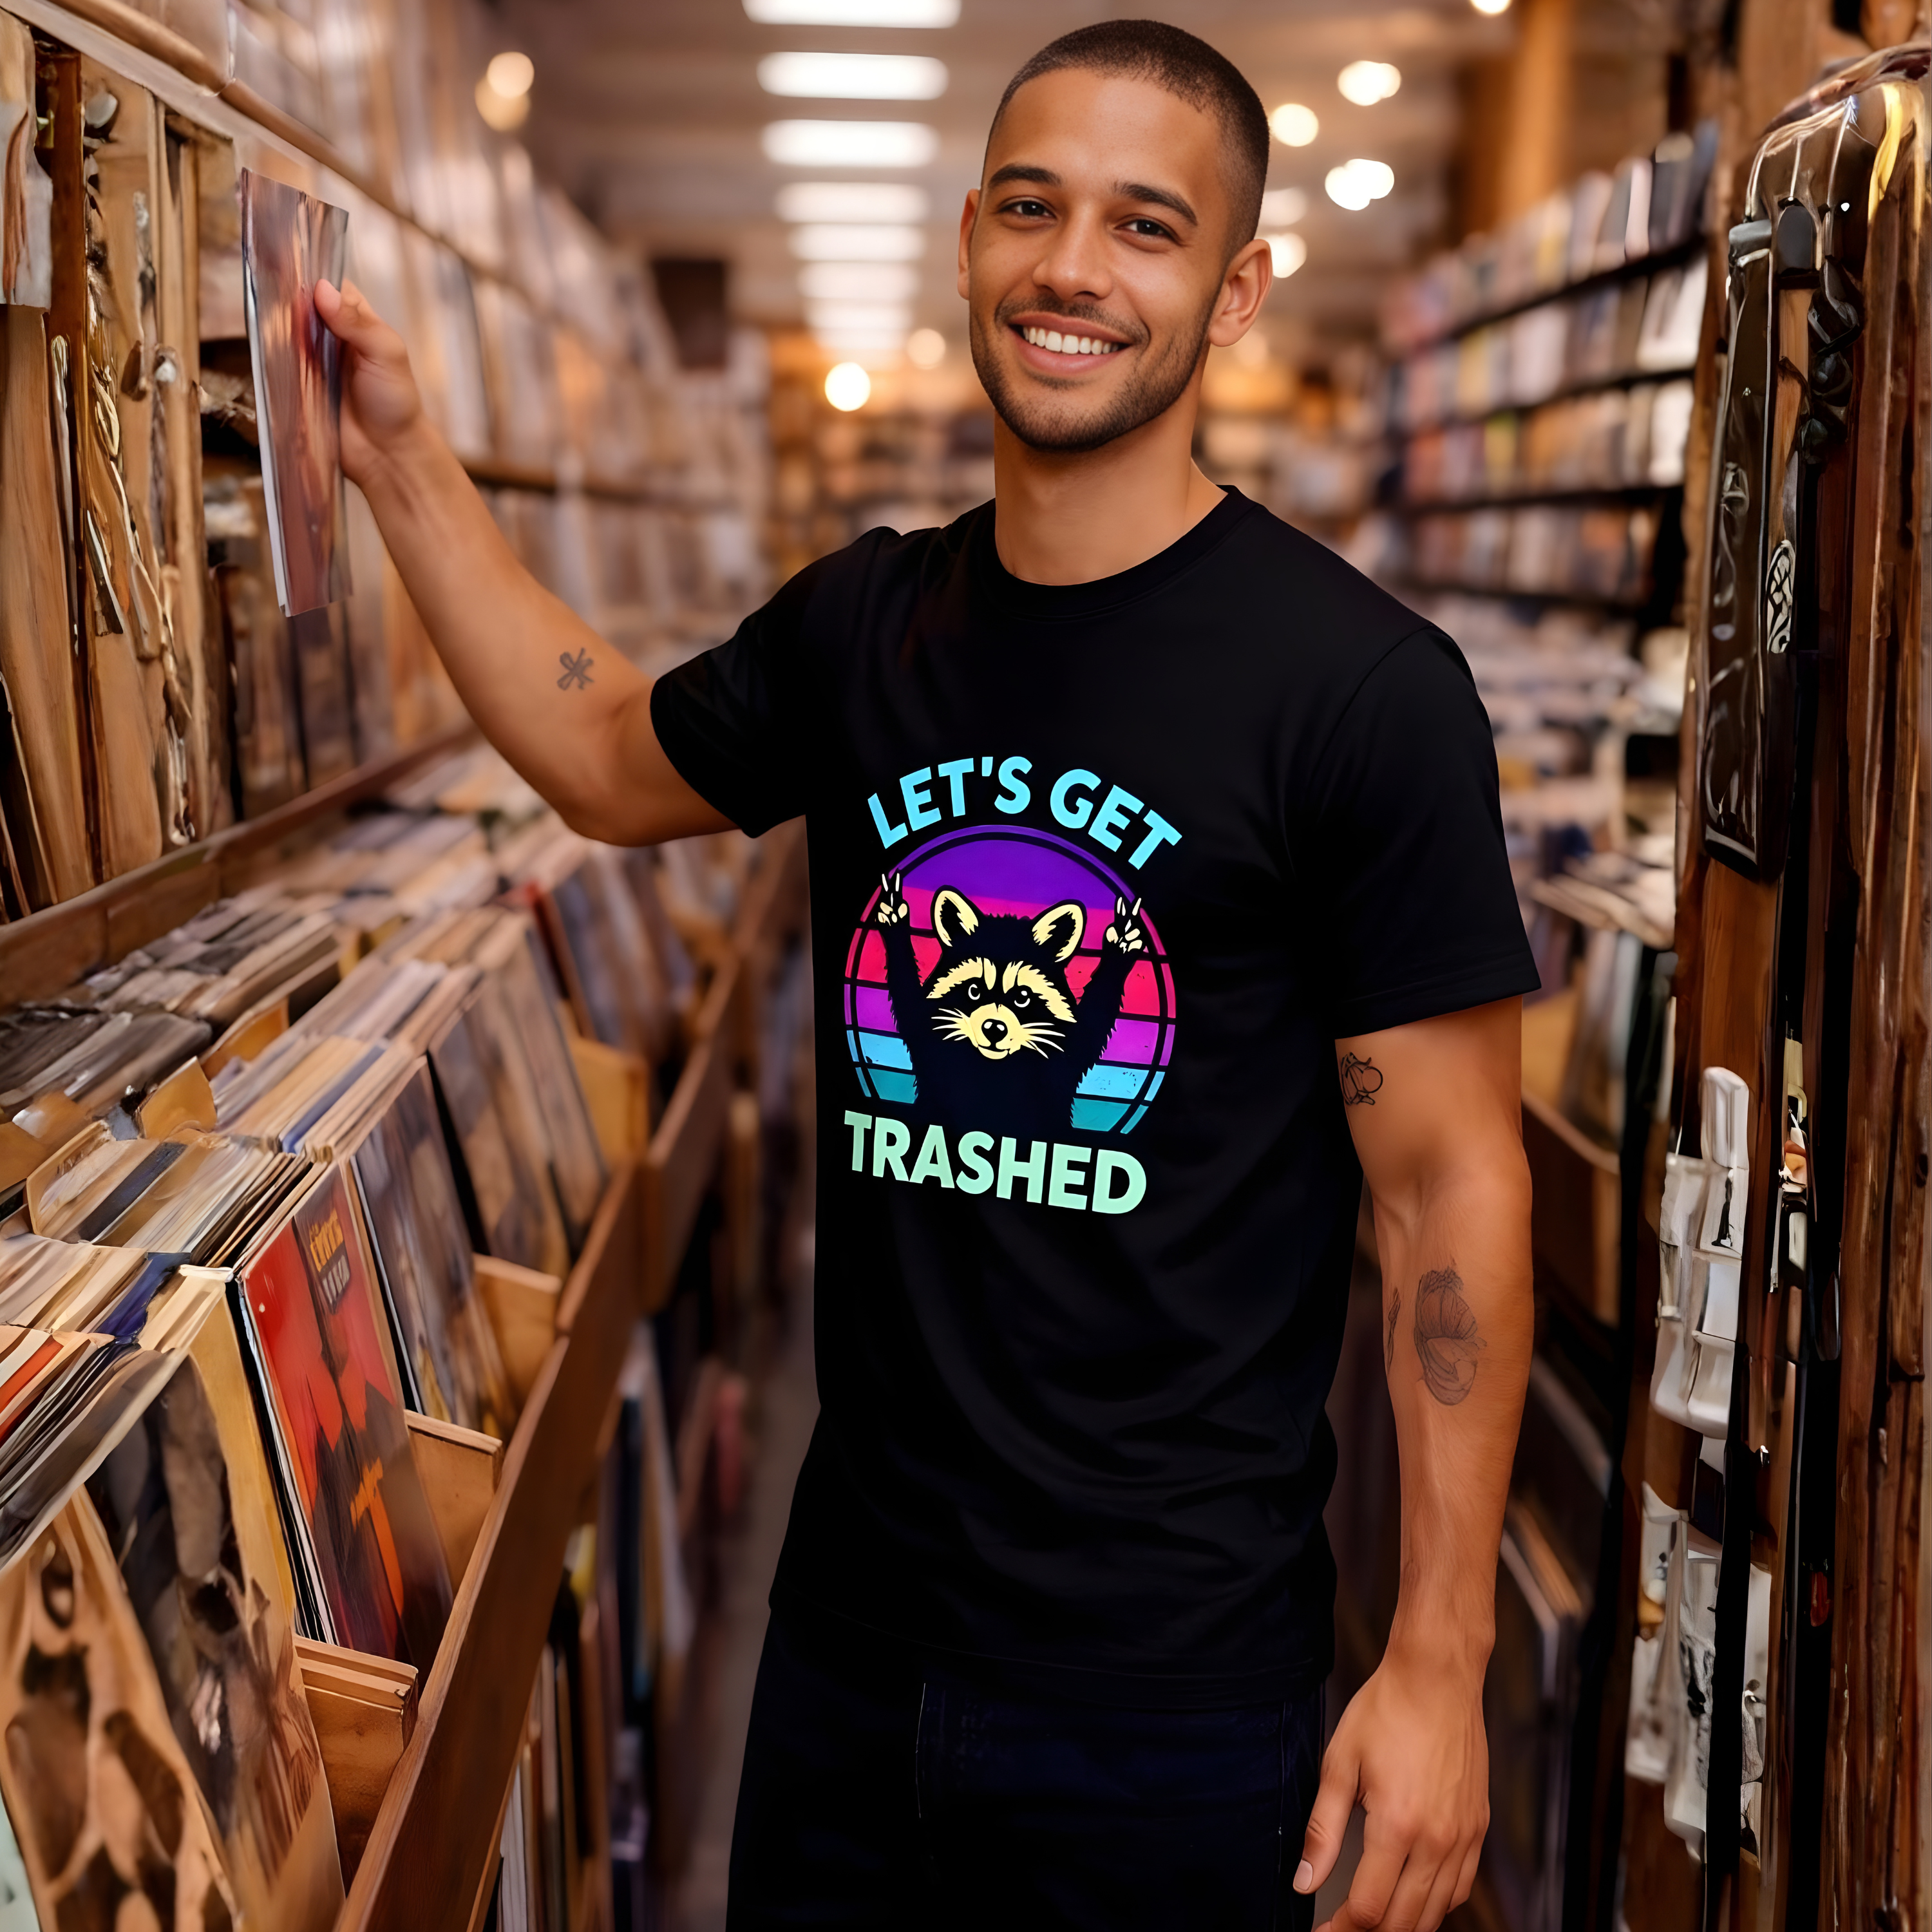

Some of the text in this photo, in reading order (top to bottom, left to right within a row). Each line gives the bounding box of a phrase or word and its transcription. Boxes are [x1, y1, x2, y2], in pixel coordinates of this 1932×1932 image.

[867, 756, 1182, 870] LET'S GET
[844, 1110, 1147, 1214] TRASHED
